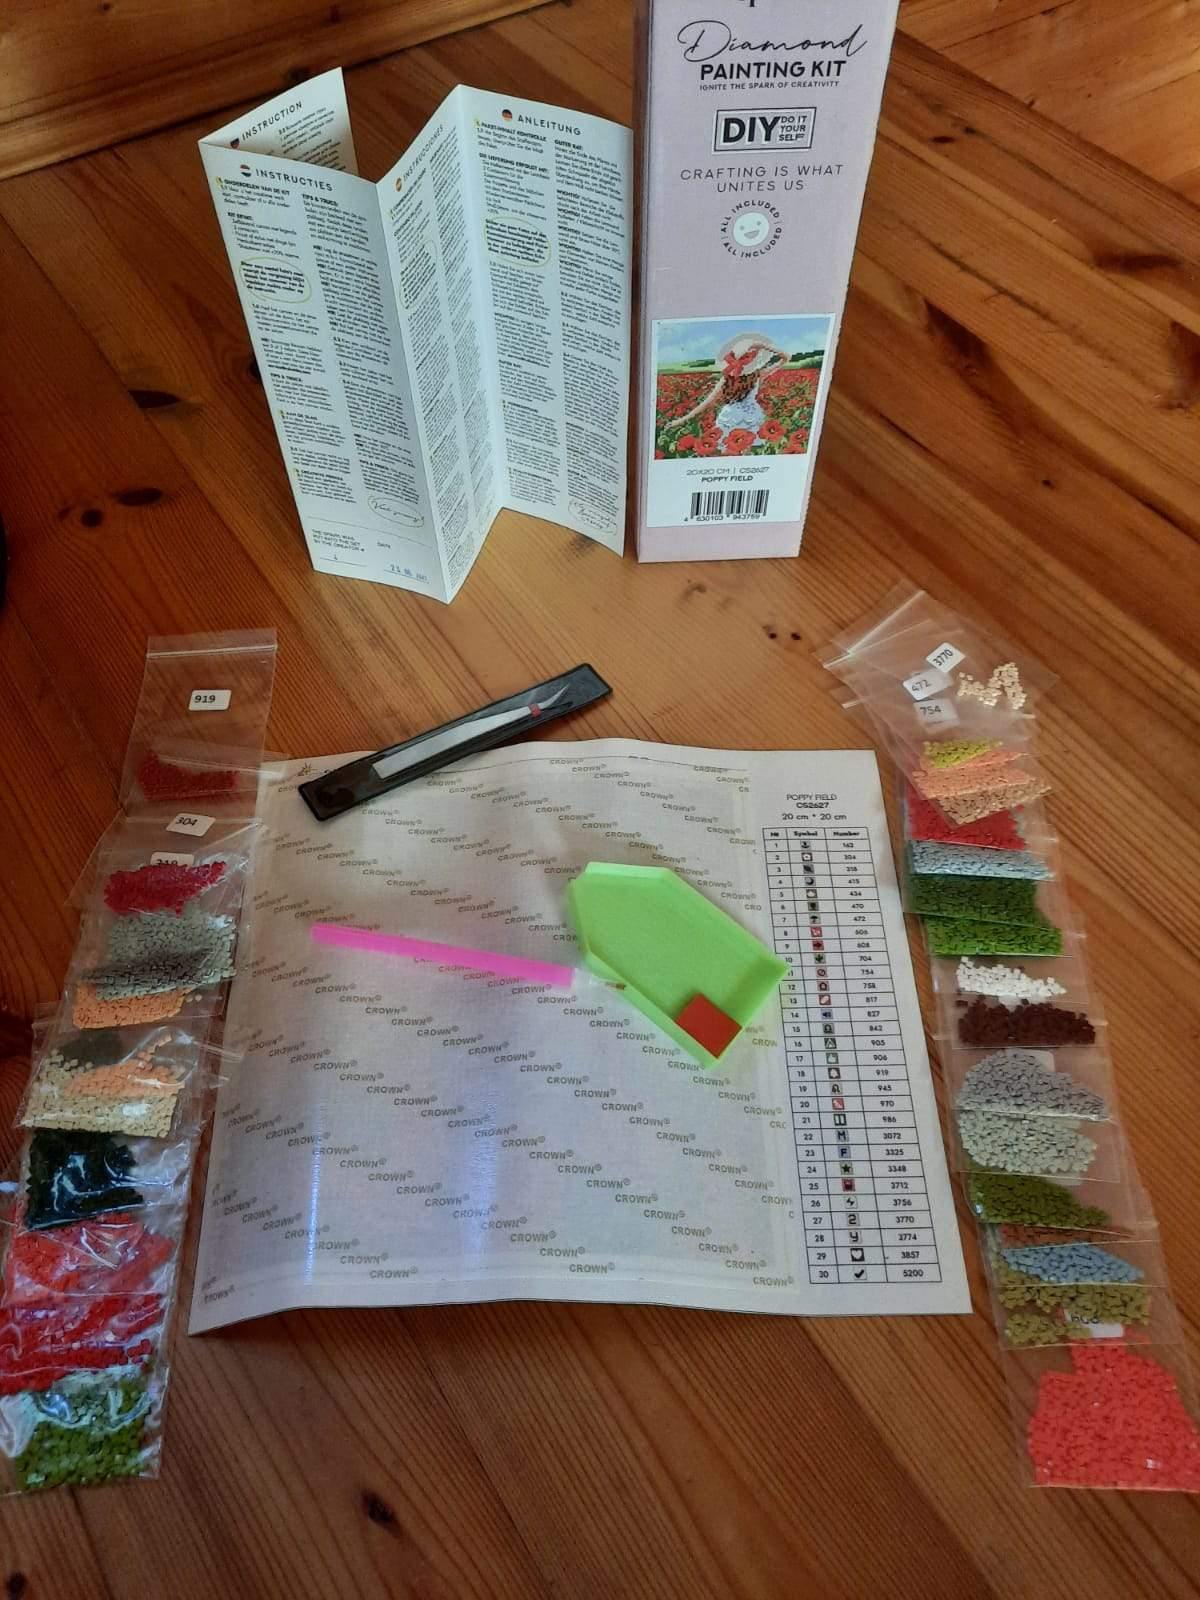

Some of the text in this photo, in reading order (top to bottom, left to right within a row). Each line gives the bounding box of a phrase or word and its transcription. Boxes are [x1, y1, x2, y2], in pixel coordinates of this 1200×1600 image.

[677, 20, 867, 62] Diamond
[700, 60, 846, 80] PAINTING KIT
[791, 80, 840, 88] CREATIVITY
[241, 100, 303, 141] INSTRUCTION
[517, 114, 582, 136] ANLEITUNG
[797, 115, 807, 123] IT
[722, 116, 781, 143] DIY
[780, 125, 806, 133] YOUR
[680, 164, 843, 181] CRAFTING IS WHAT
[256, 168, 333, 192] INSTRUCTIES
[717, 180, 804, 193] UNITES US
[720, 200, 780, 233] ALL INCLUDED
[723, 227, 782, 258] ALL INCLUDED
[716, 467, 730, 475] CM
[933, 649, 953, 667] 3770
[911, 679, 931, 692] 472
[194, 695, 216, 704] 919
[920, 705, 942, 716] 754
[175, 816, 197, 826] 304
[815, 1234, 824, 1242] 28
[816, 1251, 920, 1260] 29 3857
[903, 1269, 924, 1277] 5200
